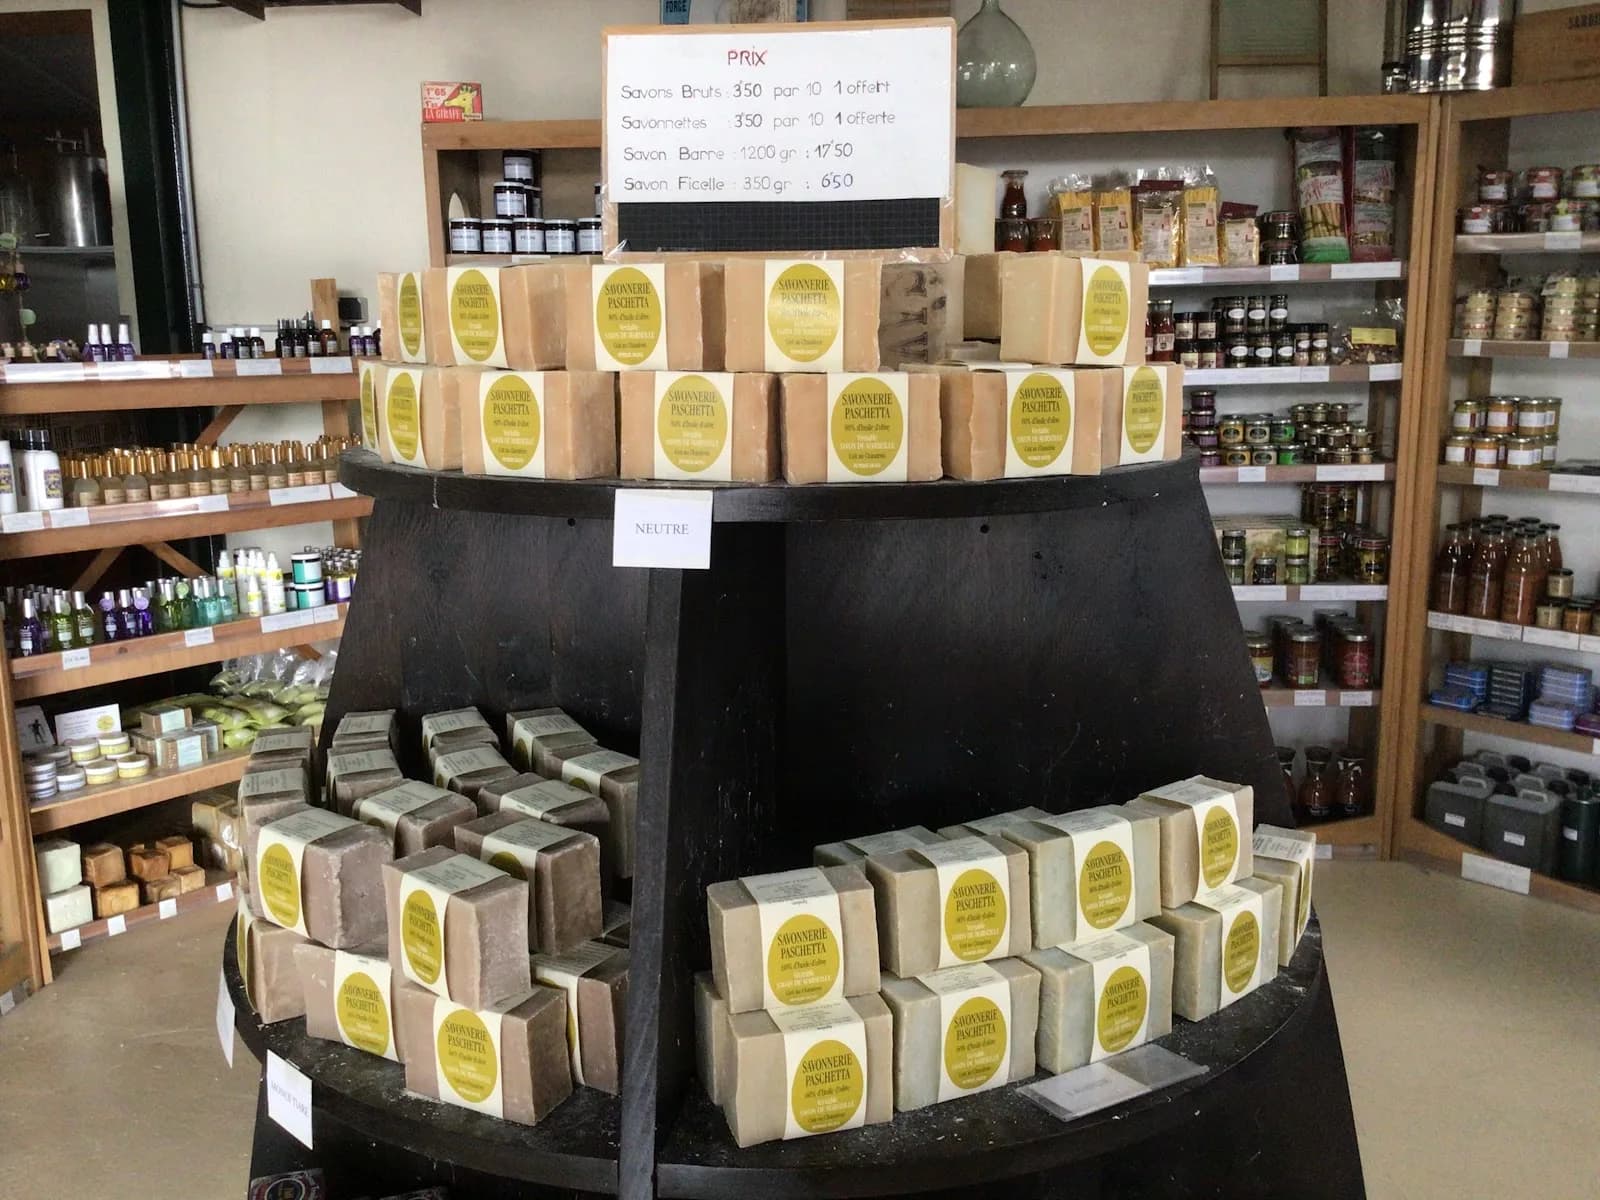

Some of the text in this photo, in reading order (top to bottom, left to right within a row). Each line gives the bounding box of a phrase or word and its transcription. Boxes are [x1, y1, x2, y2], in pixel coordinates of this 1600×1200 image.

[728, 45, 767, 66] PRIX
[621, 84, 673, 99] Savons
[681, 84, 722, 99] Bruts
[773, 86, 800, 100] par
[807, 82, 822, 96] 10
[834, 80, 842, 95] 1
[847, 80, 891, 94] offert
[621, 116, 707, 129] Savonnettes
[773, 117, 800, 131] par
[808, 112, 824, 126] 10
[835, 111, 842, 125] 1
[847, 111, 896, 125] offerte
[623, 147, 667, 161] Savon
[679, 147, 725, 161] Barre
[624, 177, 668, 191] Savon
[678, 176, 725, 191] Ficelle
[605, 282, 651, 296] SAVONNERIE
[778, 279, 830, 291] SAVONNERIE
[608, 296, 649, 309] PASCHETTA
[781, 292, 828, 305] PASCHETTA
[490, 389, 531, 403] SAVONNERIE
[669, 390, 718, 403] SAVONNERIE
[841, 392, 893, 406] SAVONNERIE
[1019, 386, 1062, 400] SAVONNERIE
[493, 403, 530, 416] PASCHETTA
[671, 404, 715, 417] PASCHETTA
[845, 407, 891, 420] PASCHETTA
[1022, 400, 1061, 413] PASCHETTA
[635, 523, 689, 535] NEUTRE
[953, 882, 997, 899] SAVONNERIE
[956, 896, 996, 912] PASCHETTA
[777, 927, 828, 947] SAVONNERIE
[780, 942, 826, 960] PASCHETTA
[954, 1009, 997, 1029] SAVONNERIE
[445, 1023, 488, 1042] SAVONNERIE
[956, 1023, 996, 1041] PASCHETTA
[448, 1035, 486, 1055] PASCHETTA
[802, 1053, 852, 1074] SAVONNERIE
[805, 1068, 851, 1088] PASCHETTA
